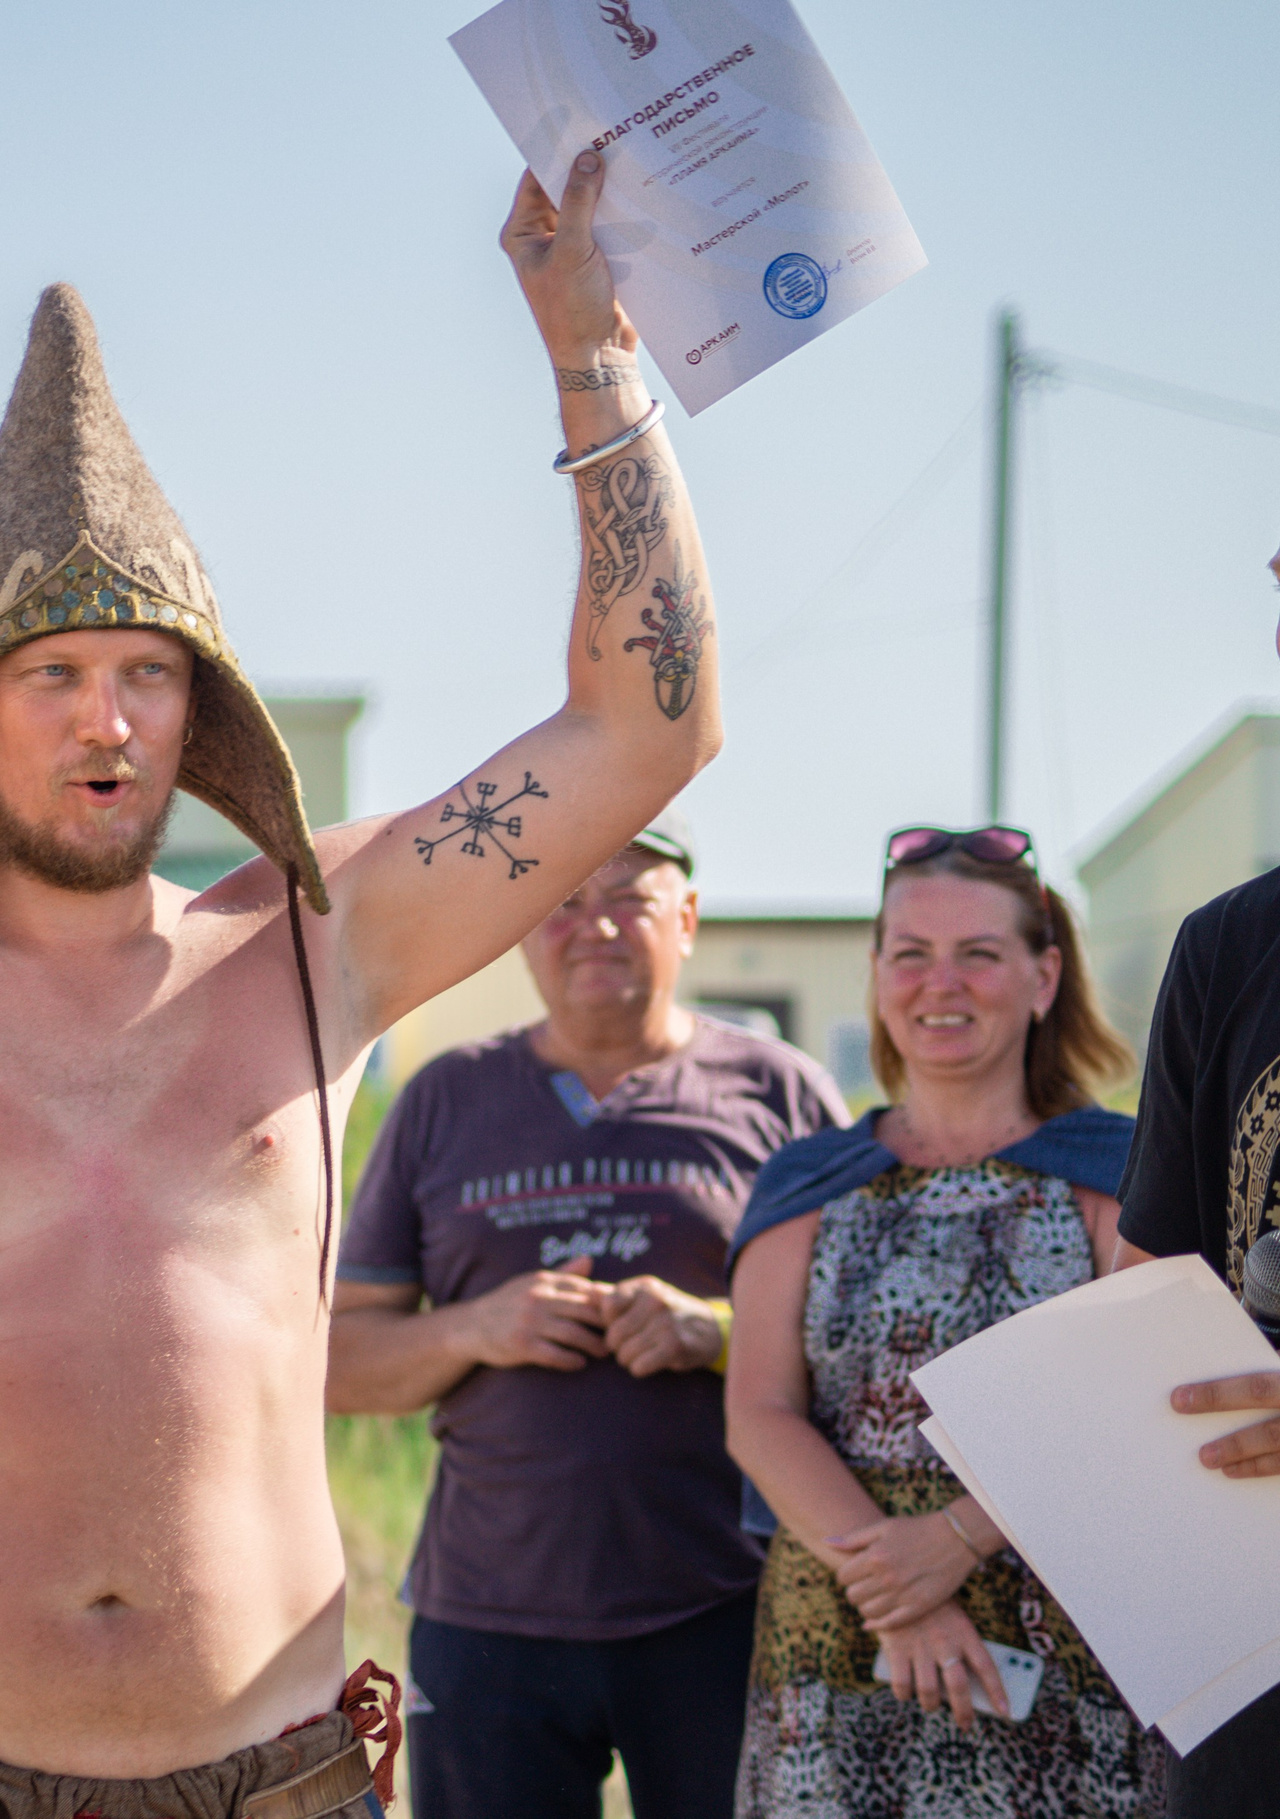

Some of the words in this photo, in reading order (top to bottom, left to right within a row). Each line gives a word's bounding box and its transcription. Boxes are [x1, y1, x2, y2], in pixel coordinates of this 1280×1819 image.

[591, 43, 756, 153] БЛАГОДАРСТВЕННОЕ
[651, 91, 720, 139] ПИСЬМО
[691, 208, 762, 257] Мастерской
[763, 180, 810, 211] «Молот»
[700, 322, 741, 353] АРКАИМ
